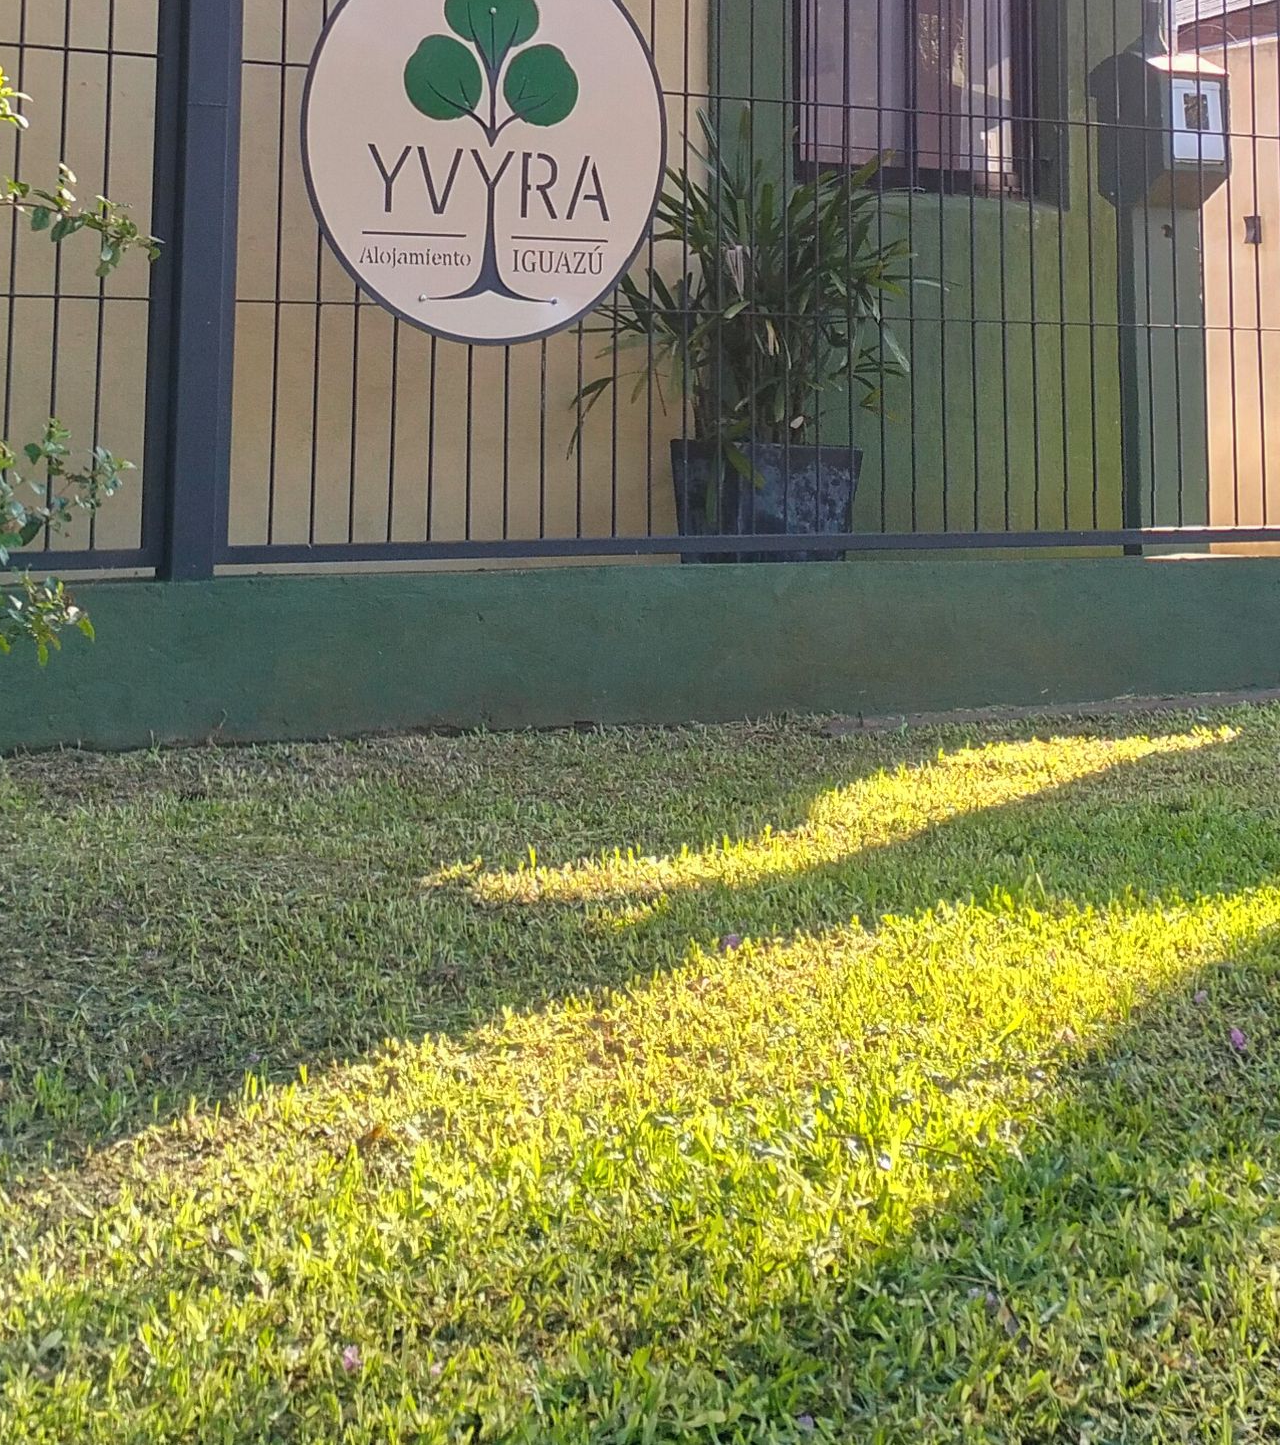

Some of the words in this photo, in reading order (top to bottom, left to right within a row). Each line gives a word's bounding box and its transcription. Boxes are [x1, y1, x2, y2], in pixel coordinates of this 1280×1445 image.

[367, 143, 610, 222] YVYRA
[358, 246, 472, 269] Alojamiento
[511, 245, 604, 275] IGUAZÚ
